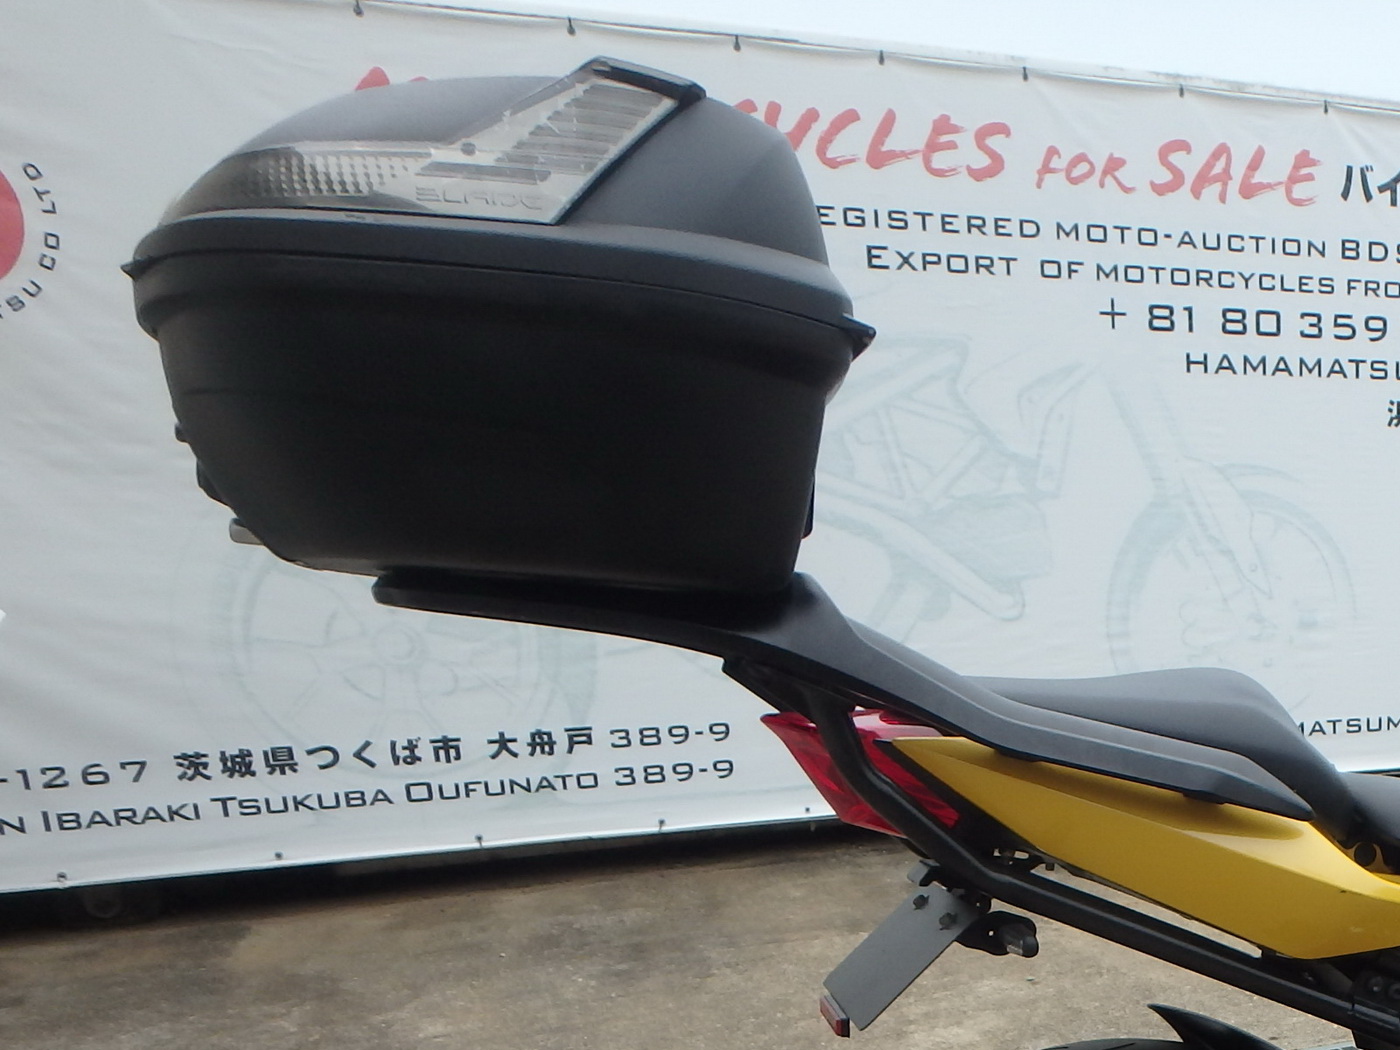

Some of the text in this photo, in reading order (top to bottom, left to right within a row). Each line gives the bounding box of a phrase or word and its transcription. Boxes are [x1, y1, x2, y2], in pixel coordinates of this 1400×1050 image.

[733, 98, 1011, 182] YCLES
[1149, 138, 1323, 207] SALE
[1056, 221, 1326, 258] MOTO-AUCTION
[866, 244, 1018, 276] EXPORT
[1040, 259, 1084, 280] OF
[1096, 262, 1335, 295] MOTORCYCLES
[0, 279, 42, 319] SU
[1148, 303, 1193, 333] 81
[1221, 307, 1282, 337] 80
[1299, 312, 1388, 342] 359
[173, 735, 463, 781] 茨城県つくば市
[486, 726, 593, 759] 大舟戸
[609, 722, 730, 749] 389-9
[41, 802, 201, 832] IBARAKI
[209, 789, 395, 817] TSUKUBA
[404, 771, 599, 802] OUFUNATO
[613, 759, 735, 786] 389-9
